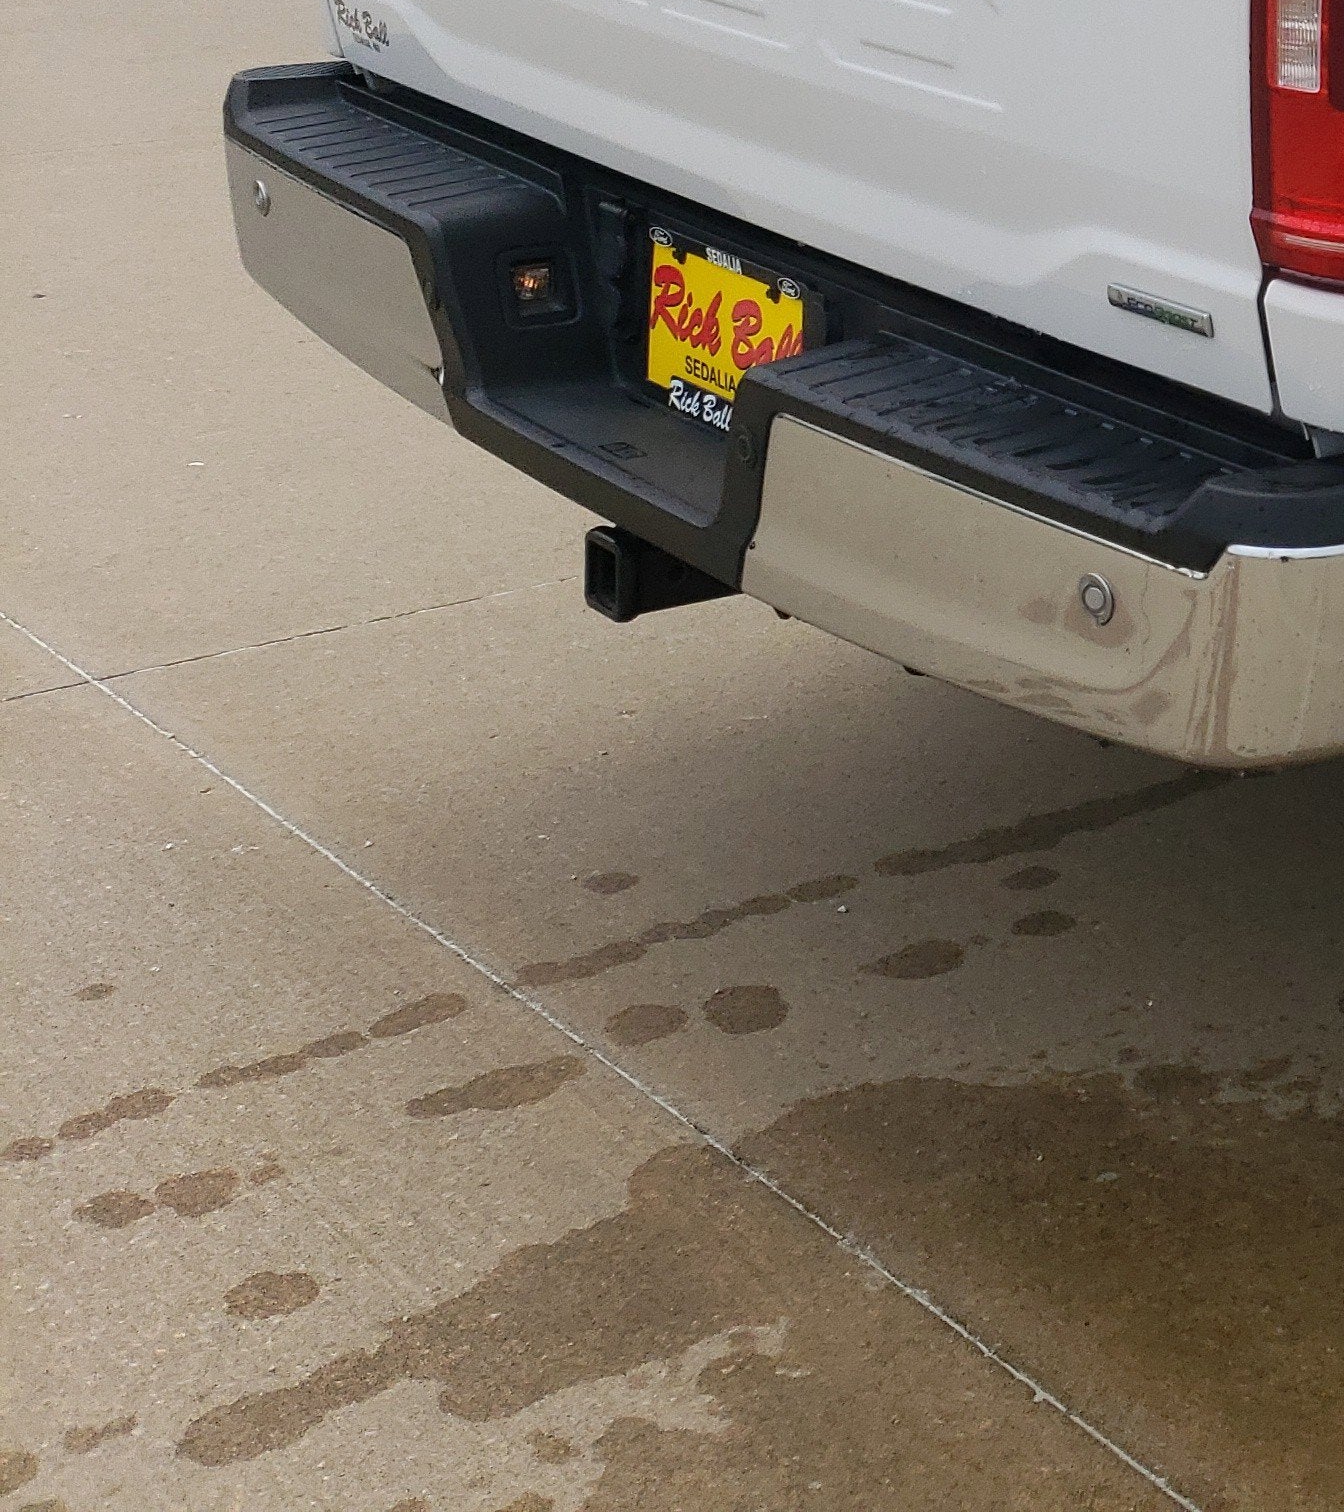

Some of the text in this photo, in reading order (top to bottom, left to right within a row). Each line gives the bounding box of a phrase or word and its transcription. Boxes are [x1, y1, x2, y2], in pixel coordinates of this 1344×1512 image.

[706, 246, 742, 275] SEDALIA
[650, 264, 722, 357] Rick
[685, 354, 736, 392] SEDALIA
[668, 379, 734, 432] Rick Ball
